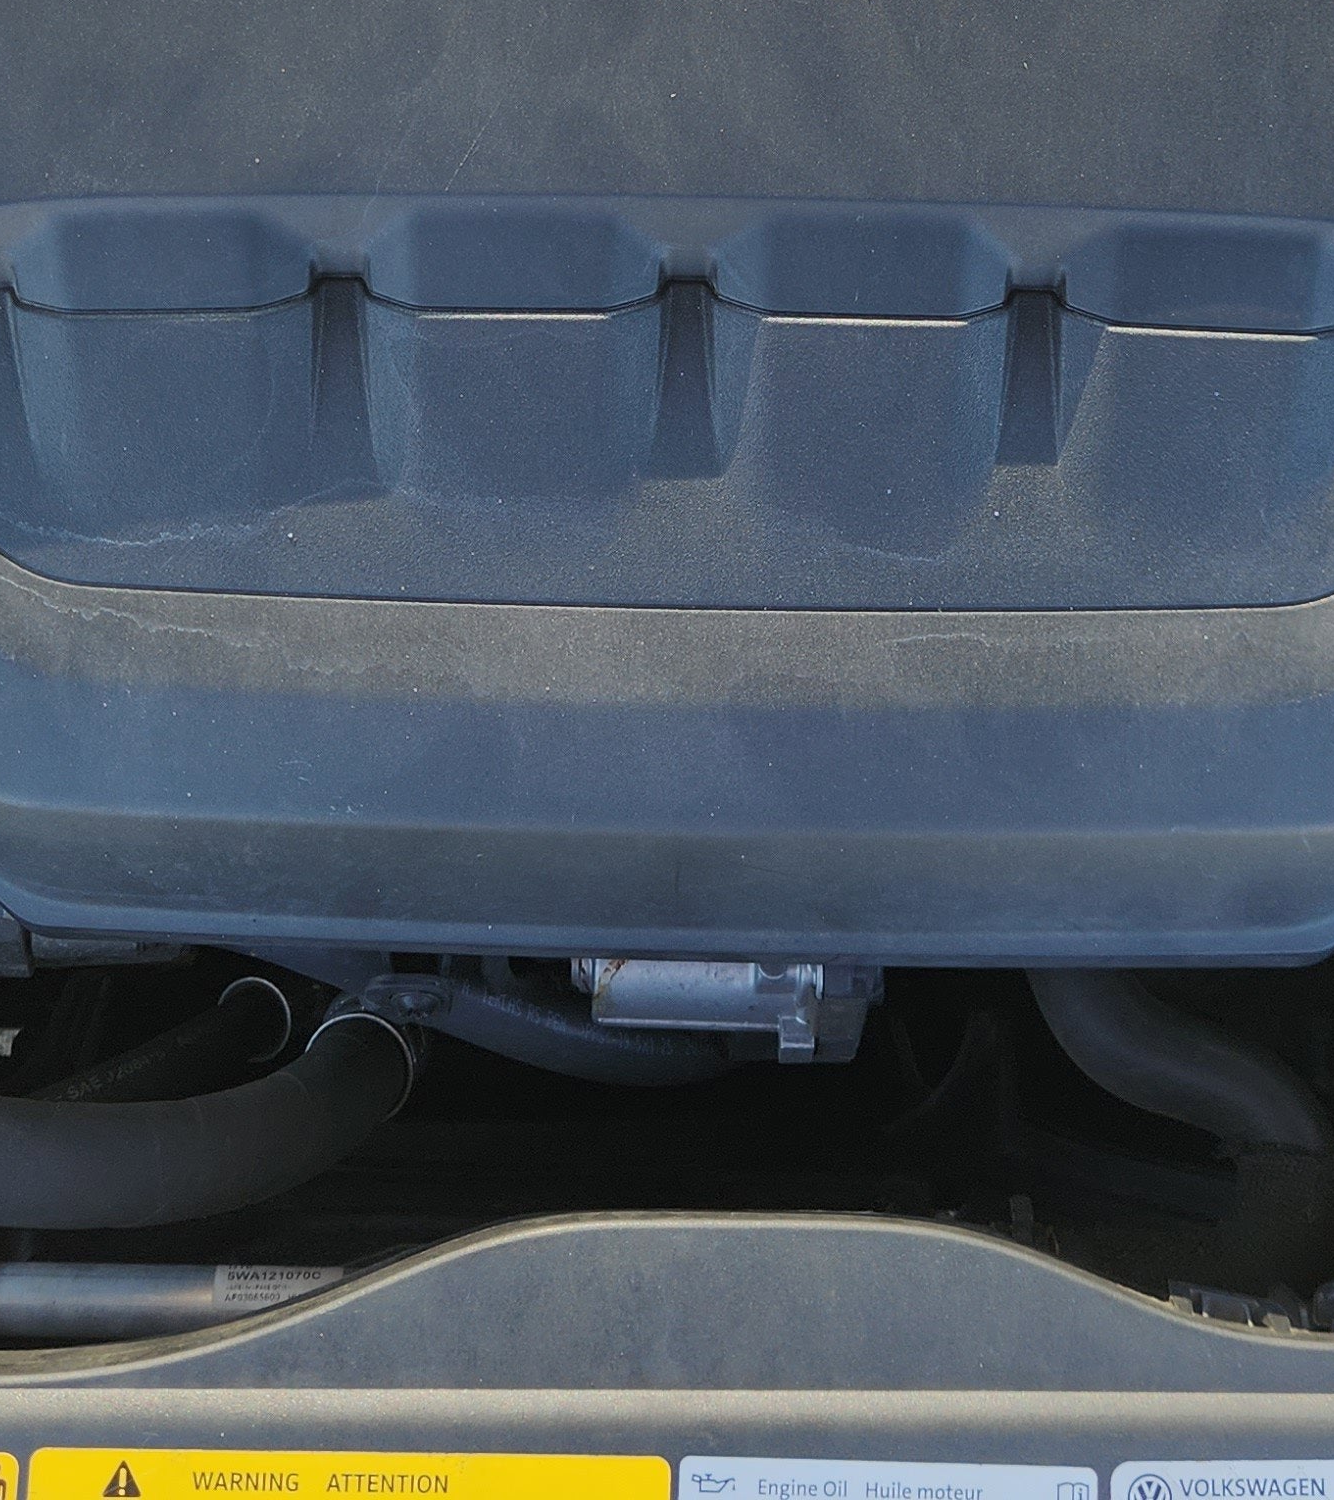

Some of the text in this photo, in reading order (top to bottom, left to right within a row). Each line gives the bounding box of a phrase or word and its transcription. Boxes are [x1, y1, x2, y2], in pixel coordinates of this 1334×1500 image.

[191, 1472, 450, 1494] WARNING ATTENTION
[757, 1478, 984, 1500] Engine Oil Huile moteur
[1179, 1477, 1325, 1497] VOLKSWAGEN
